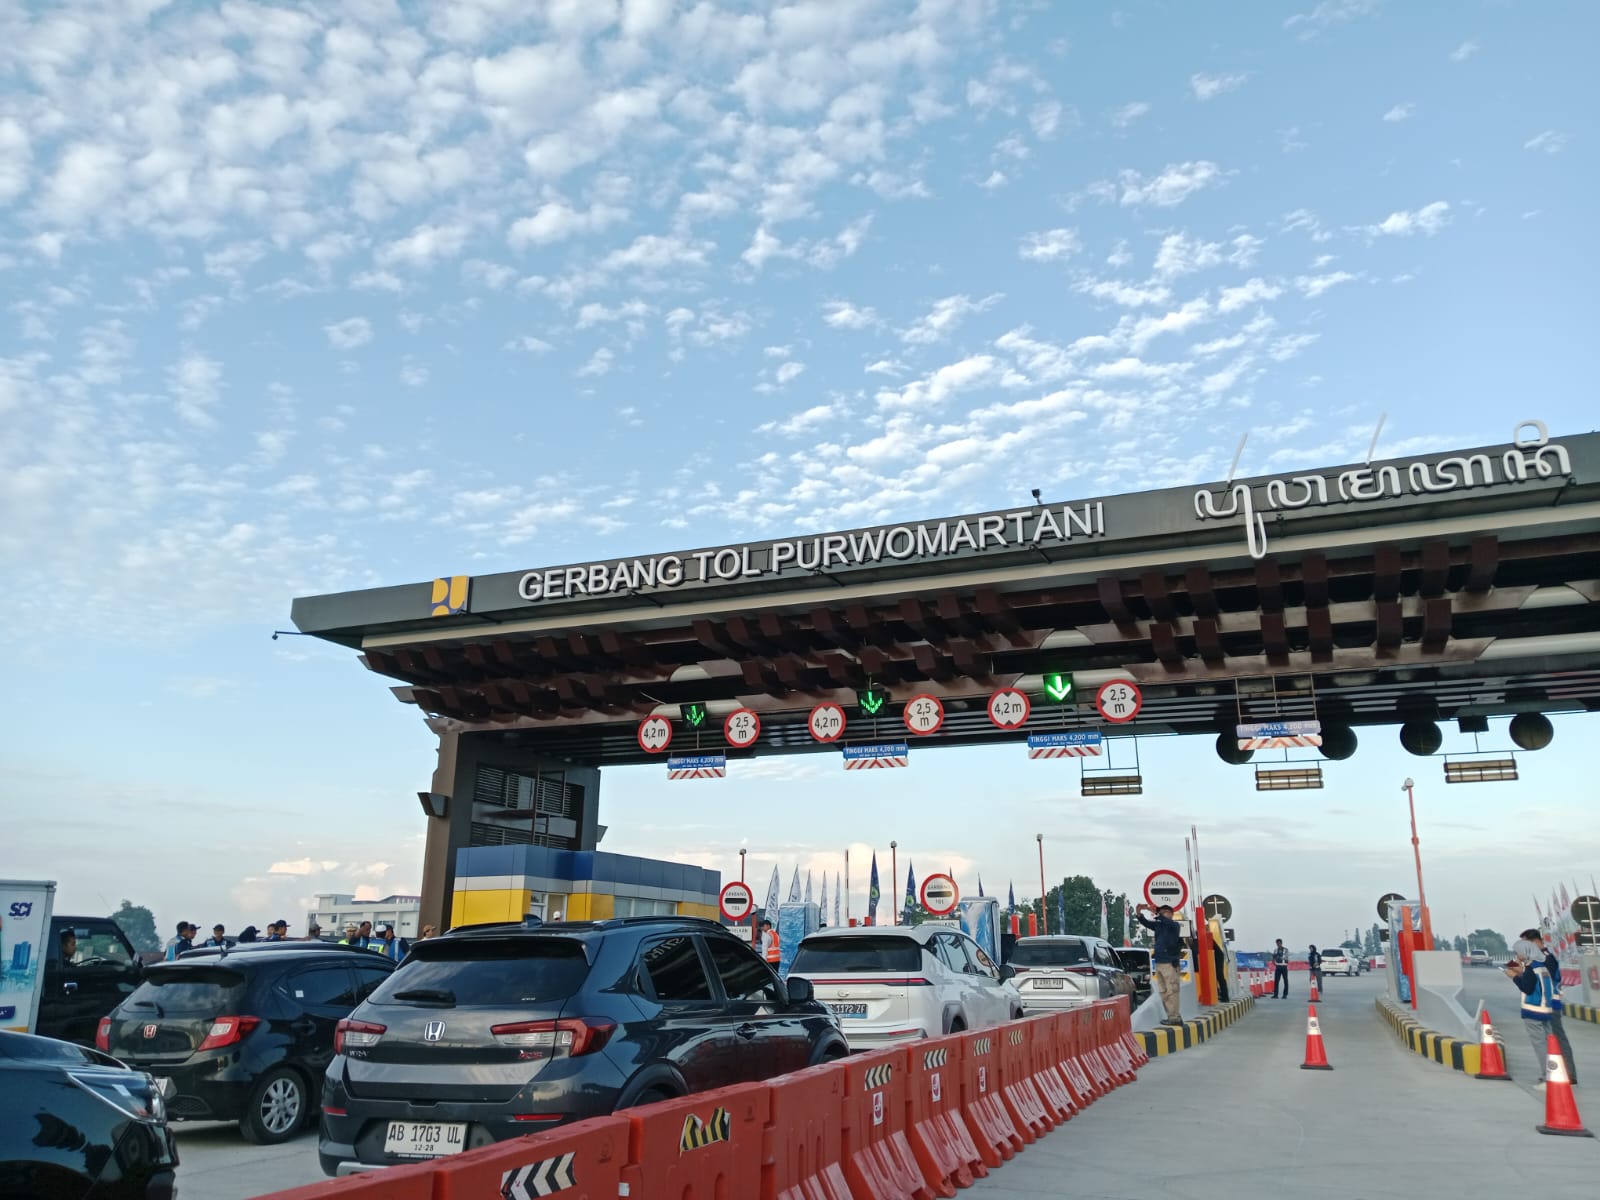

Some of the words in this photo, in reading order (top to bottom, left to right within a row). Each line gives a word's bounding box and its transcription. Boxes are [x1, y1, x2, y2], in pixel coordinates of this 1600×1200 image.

[518, 556, 683, 601] GERBANG
[693, 548, 761, 581] TOL
[772, 502, 1105, 573] PURWOMARTANI
[1110, 688, 1127, 702] 2,5
[916, 702, 931, 716] 2,5
[994, 702, 1010, 716] 4,2
[1012, 703, 1022, 713] m
[1114, 703, 1125, 714] m
[735, 717, 749, 729] 2,5
[814, 717, 829, 729] 4,2
[830, 718, 839, 727] m
[920, 717, 929, 727] m
[643, 728, 656, 739] 4,2
[657, 728, 666, 737] m
[738, 730, 747, 739] m
[388, 1124, 405, 1141] AB
[411, 1125, 442, 1143] 1703
[447, 1126, 461, 1144] UL
